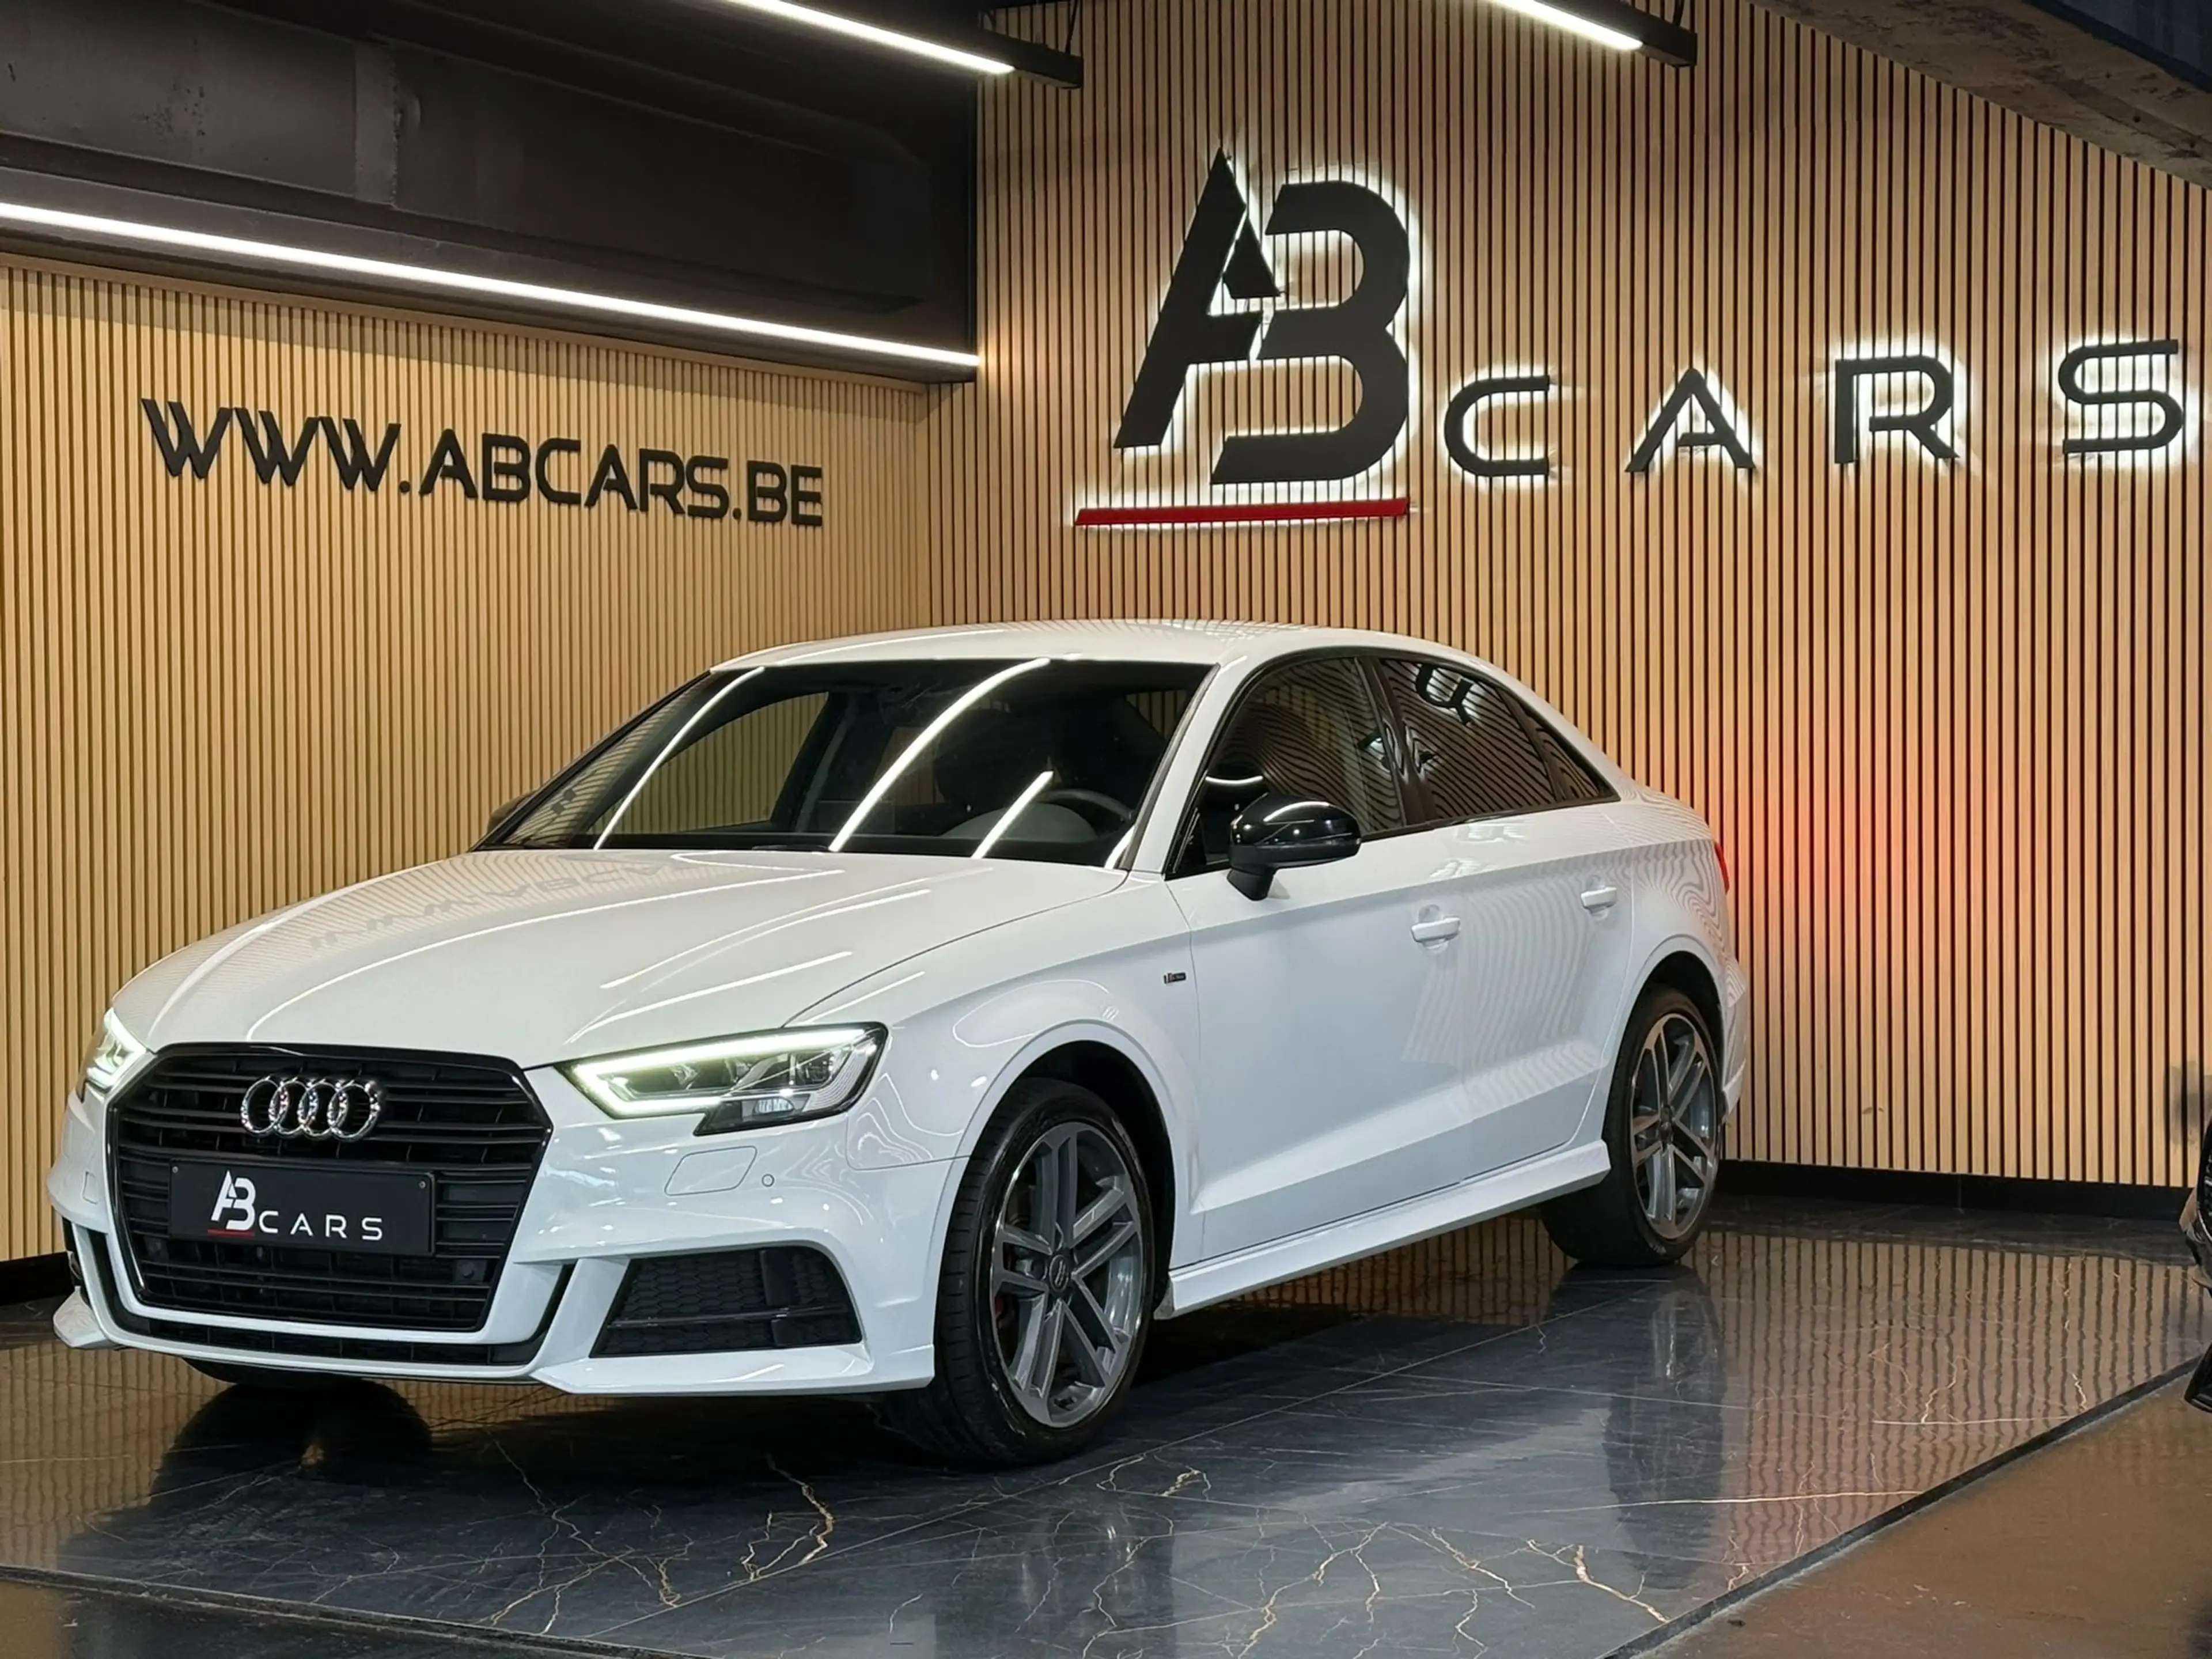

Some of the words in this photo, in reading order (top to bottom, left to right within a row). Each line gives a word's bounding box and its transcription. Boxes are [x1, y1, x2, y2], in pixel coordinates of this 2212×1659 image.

[1113, 147, 1411, 486] AB
[1443, 339, 2184, 478] CARS
[141, 397, 824, 527] WWW.ABCARS.BE
[210, 1170, 257, 1232] AB
[258, 1210, 383, 1241] CARS
